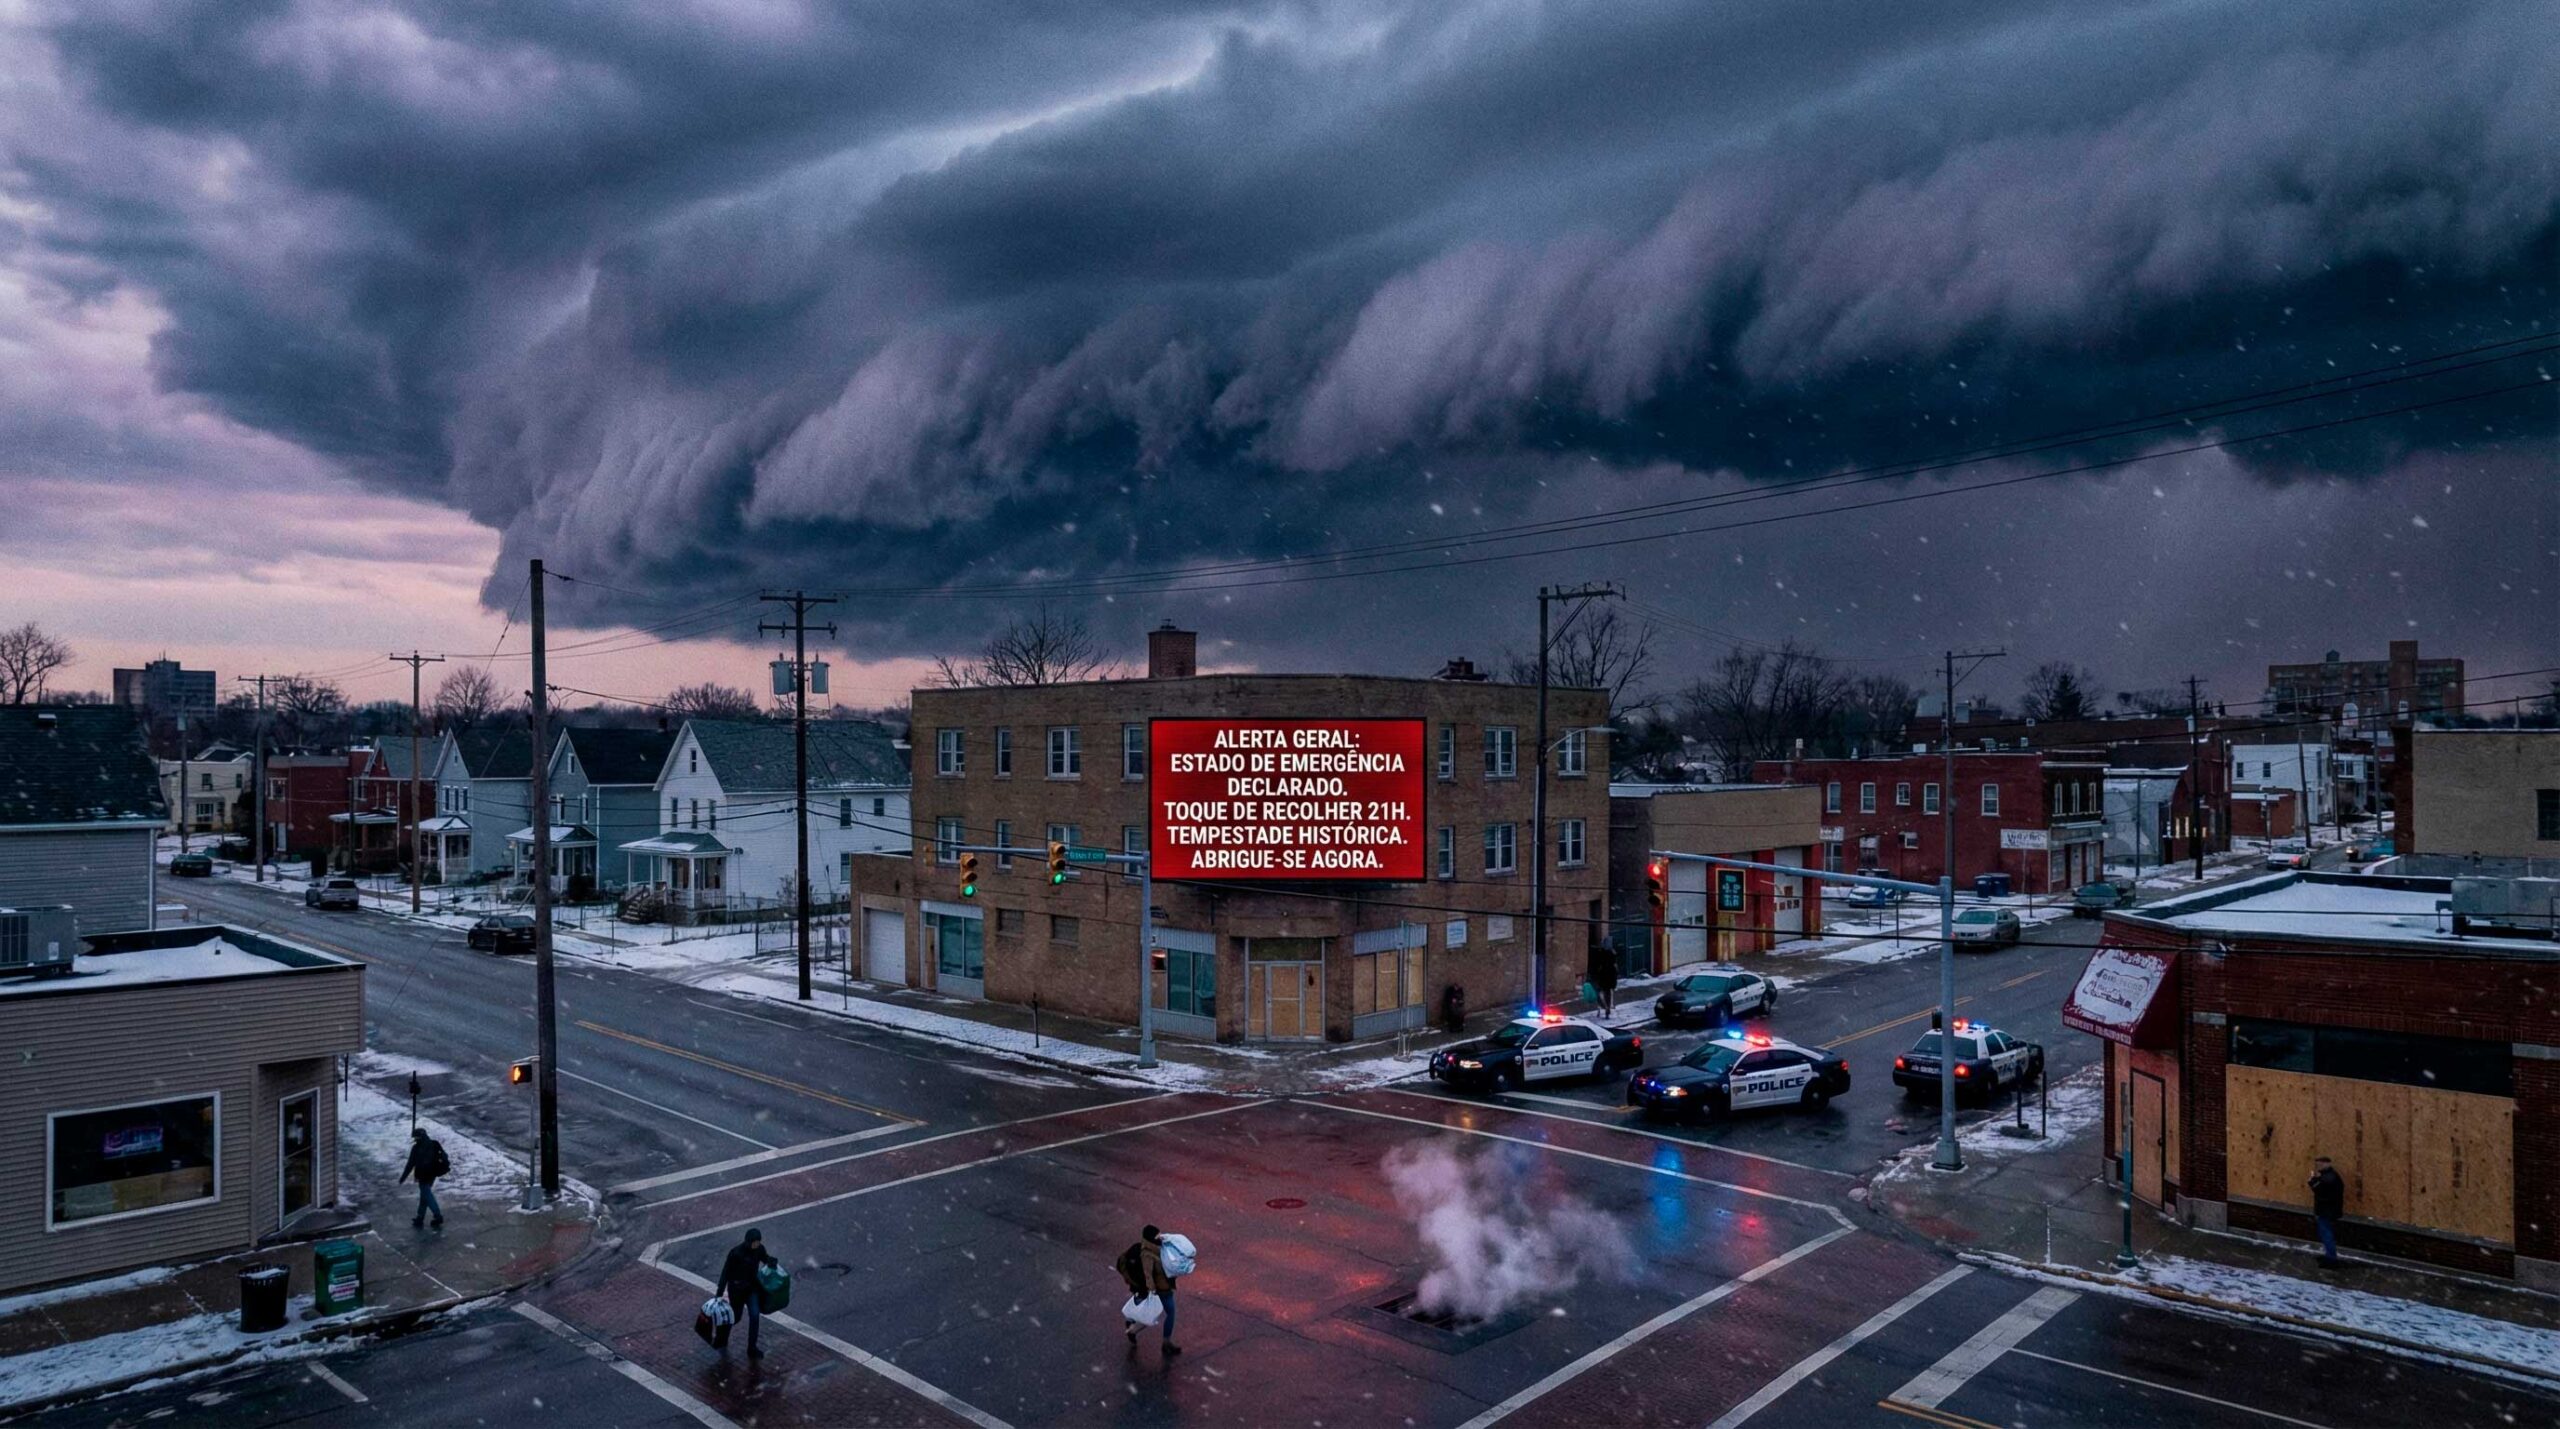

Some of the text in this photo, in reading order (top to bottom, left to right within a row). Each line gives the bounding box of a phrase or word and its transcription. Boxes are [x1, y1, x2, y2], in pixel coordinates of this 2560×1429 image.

[1214, 730, 1360, 749] ALERTA GERAL:
[1171, 750, 1405, 773] ESTADO DE EMERGÊNCIA
[1227, 777, 1348, 797] DECLARADO.
[1164, 802, 1411, 823] TOQUE DE RECOLHER 21H.
[1167, 821, 1408, 845] TEMPESTADE HISTÓRICA.
[1191, 850, 1384, 869] ABRIGUE-SE AGORA.
[1541, 1051, 1594, 1067] POLICE
[1748, 1076, 1804, 1094] POLICE
